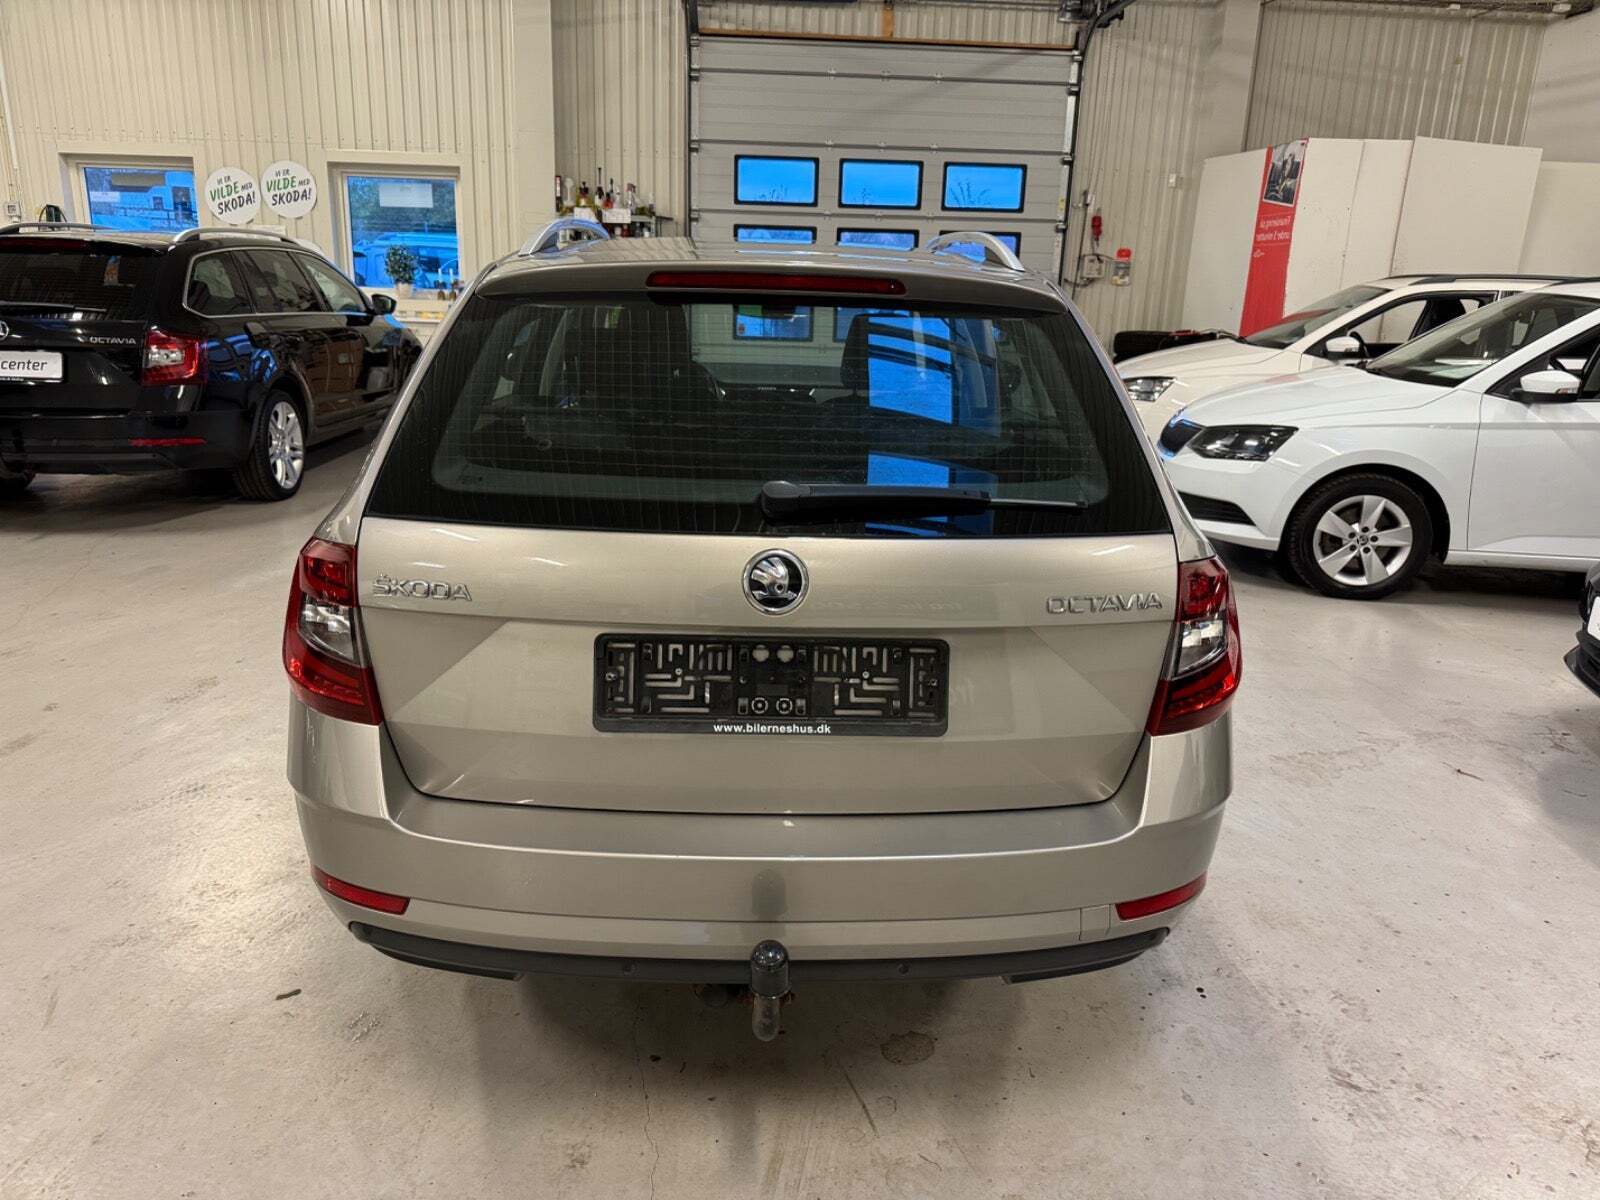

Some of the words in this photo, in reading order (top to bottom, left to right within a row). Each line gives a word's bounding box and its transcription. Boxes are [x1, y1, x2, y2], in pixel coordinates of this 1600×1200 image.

[224, 175, 231, 183] ER
[282, 168, 290, 176] ER
[209, 181, 239, 202] VILDE
[241, 182, 253, 192] MED
[266, 176, 296, 193] VILDE
[298, 178, 310, 187] MED
[217, 191, 256, 215] SKODA!
[271, 188, 312, 206] SKODA!
[89, 336, 136, 345] OCTAVIA
[373, 573, 473, 602] ŠKODA
[1046, 592, 1163, 614] OCTAVIA
[713, 723, 831, 734] www.bilerneshus.dk
